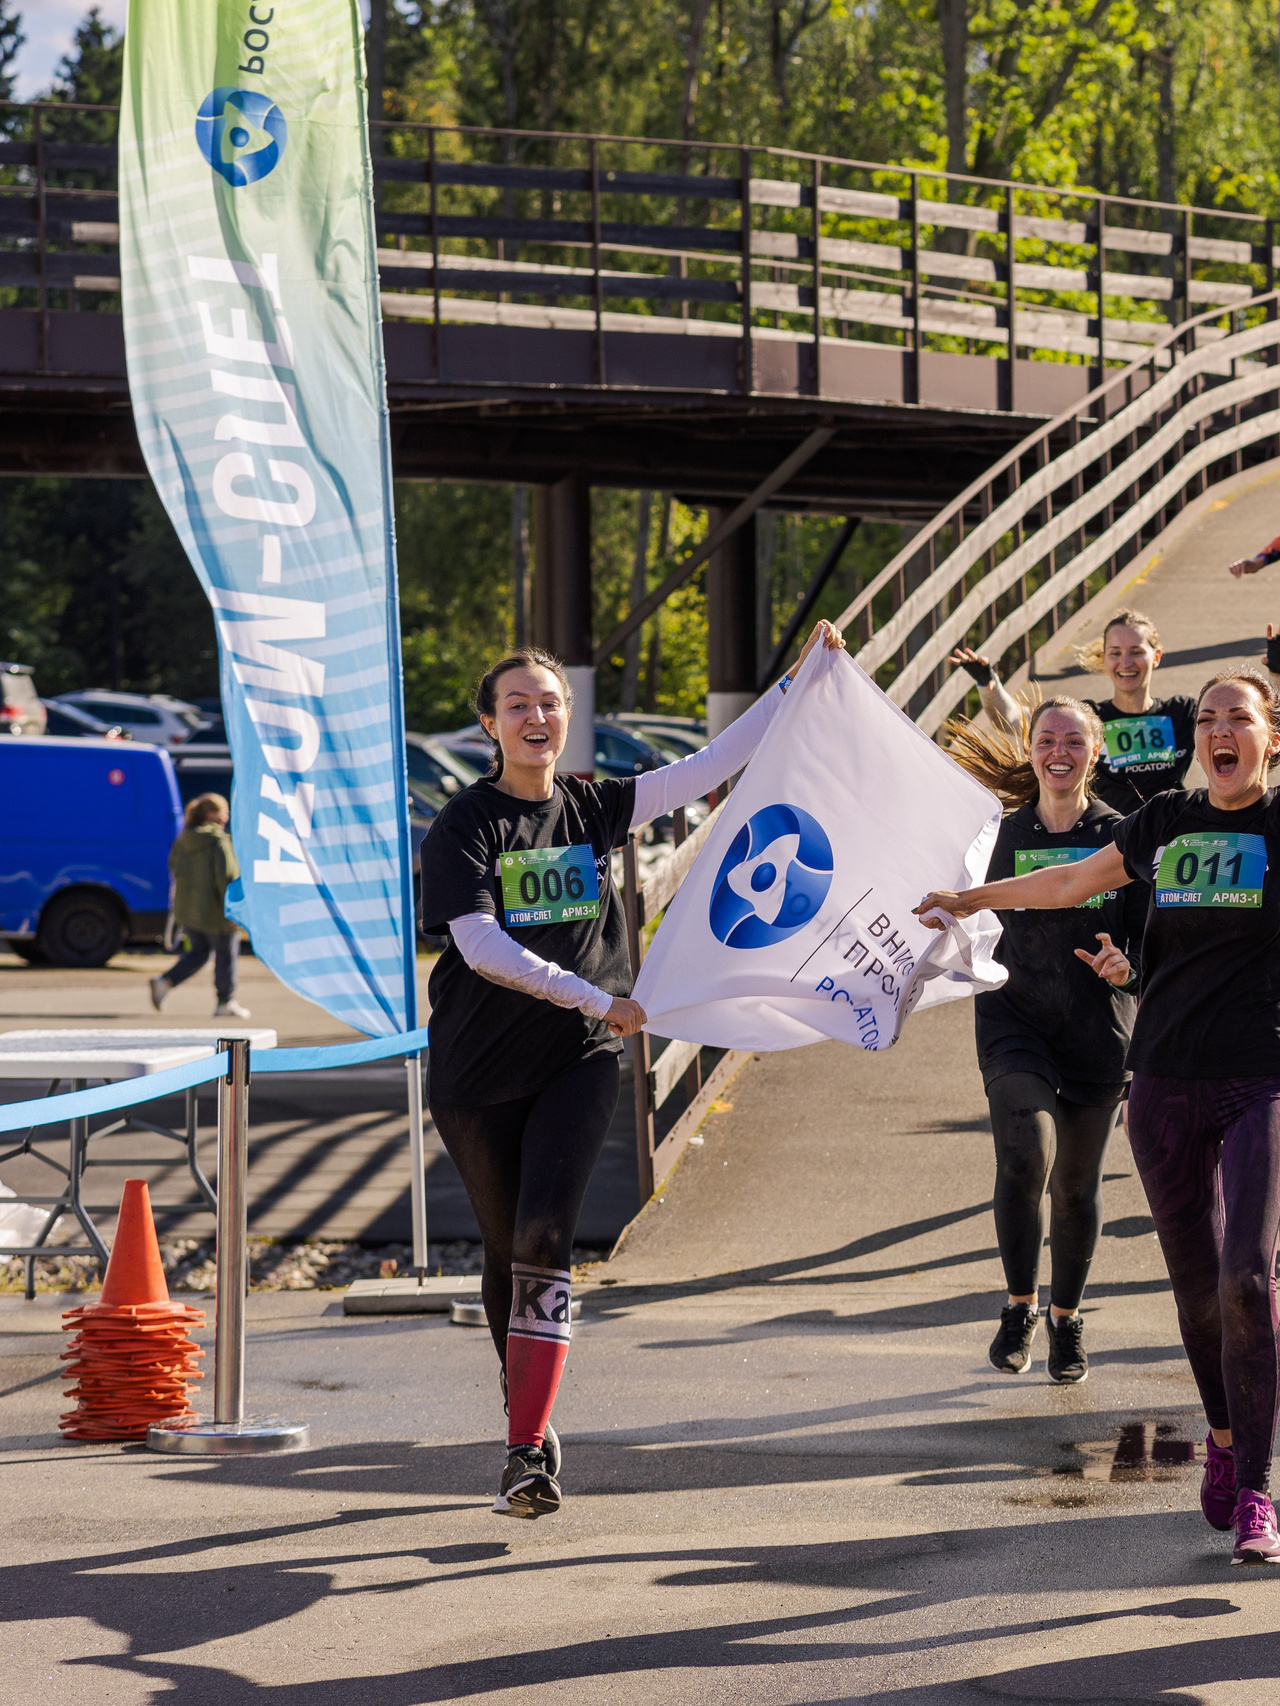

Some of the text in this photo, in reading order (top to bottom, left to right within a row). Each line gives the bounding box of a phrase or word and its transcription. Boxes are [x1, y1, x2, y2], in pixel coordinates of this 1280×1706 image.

[1116, 728, 1166, 752] 018
[1175, 851, 1243, 886] 011
[520, 866, 585, 904] 006
[1160, 893, 1203, 904] АТОМ-СЛЕТ
[510, 909, 552, 924] АТОМ-СЛЕТ
[515, 1278, 572, 1335] Ka
